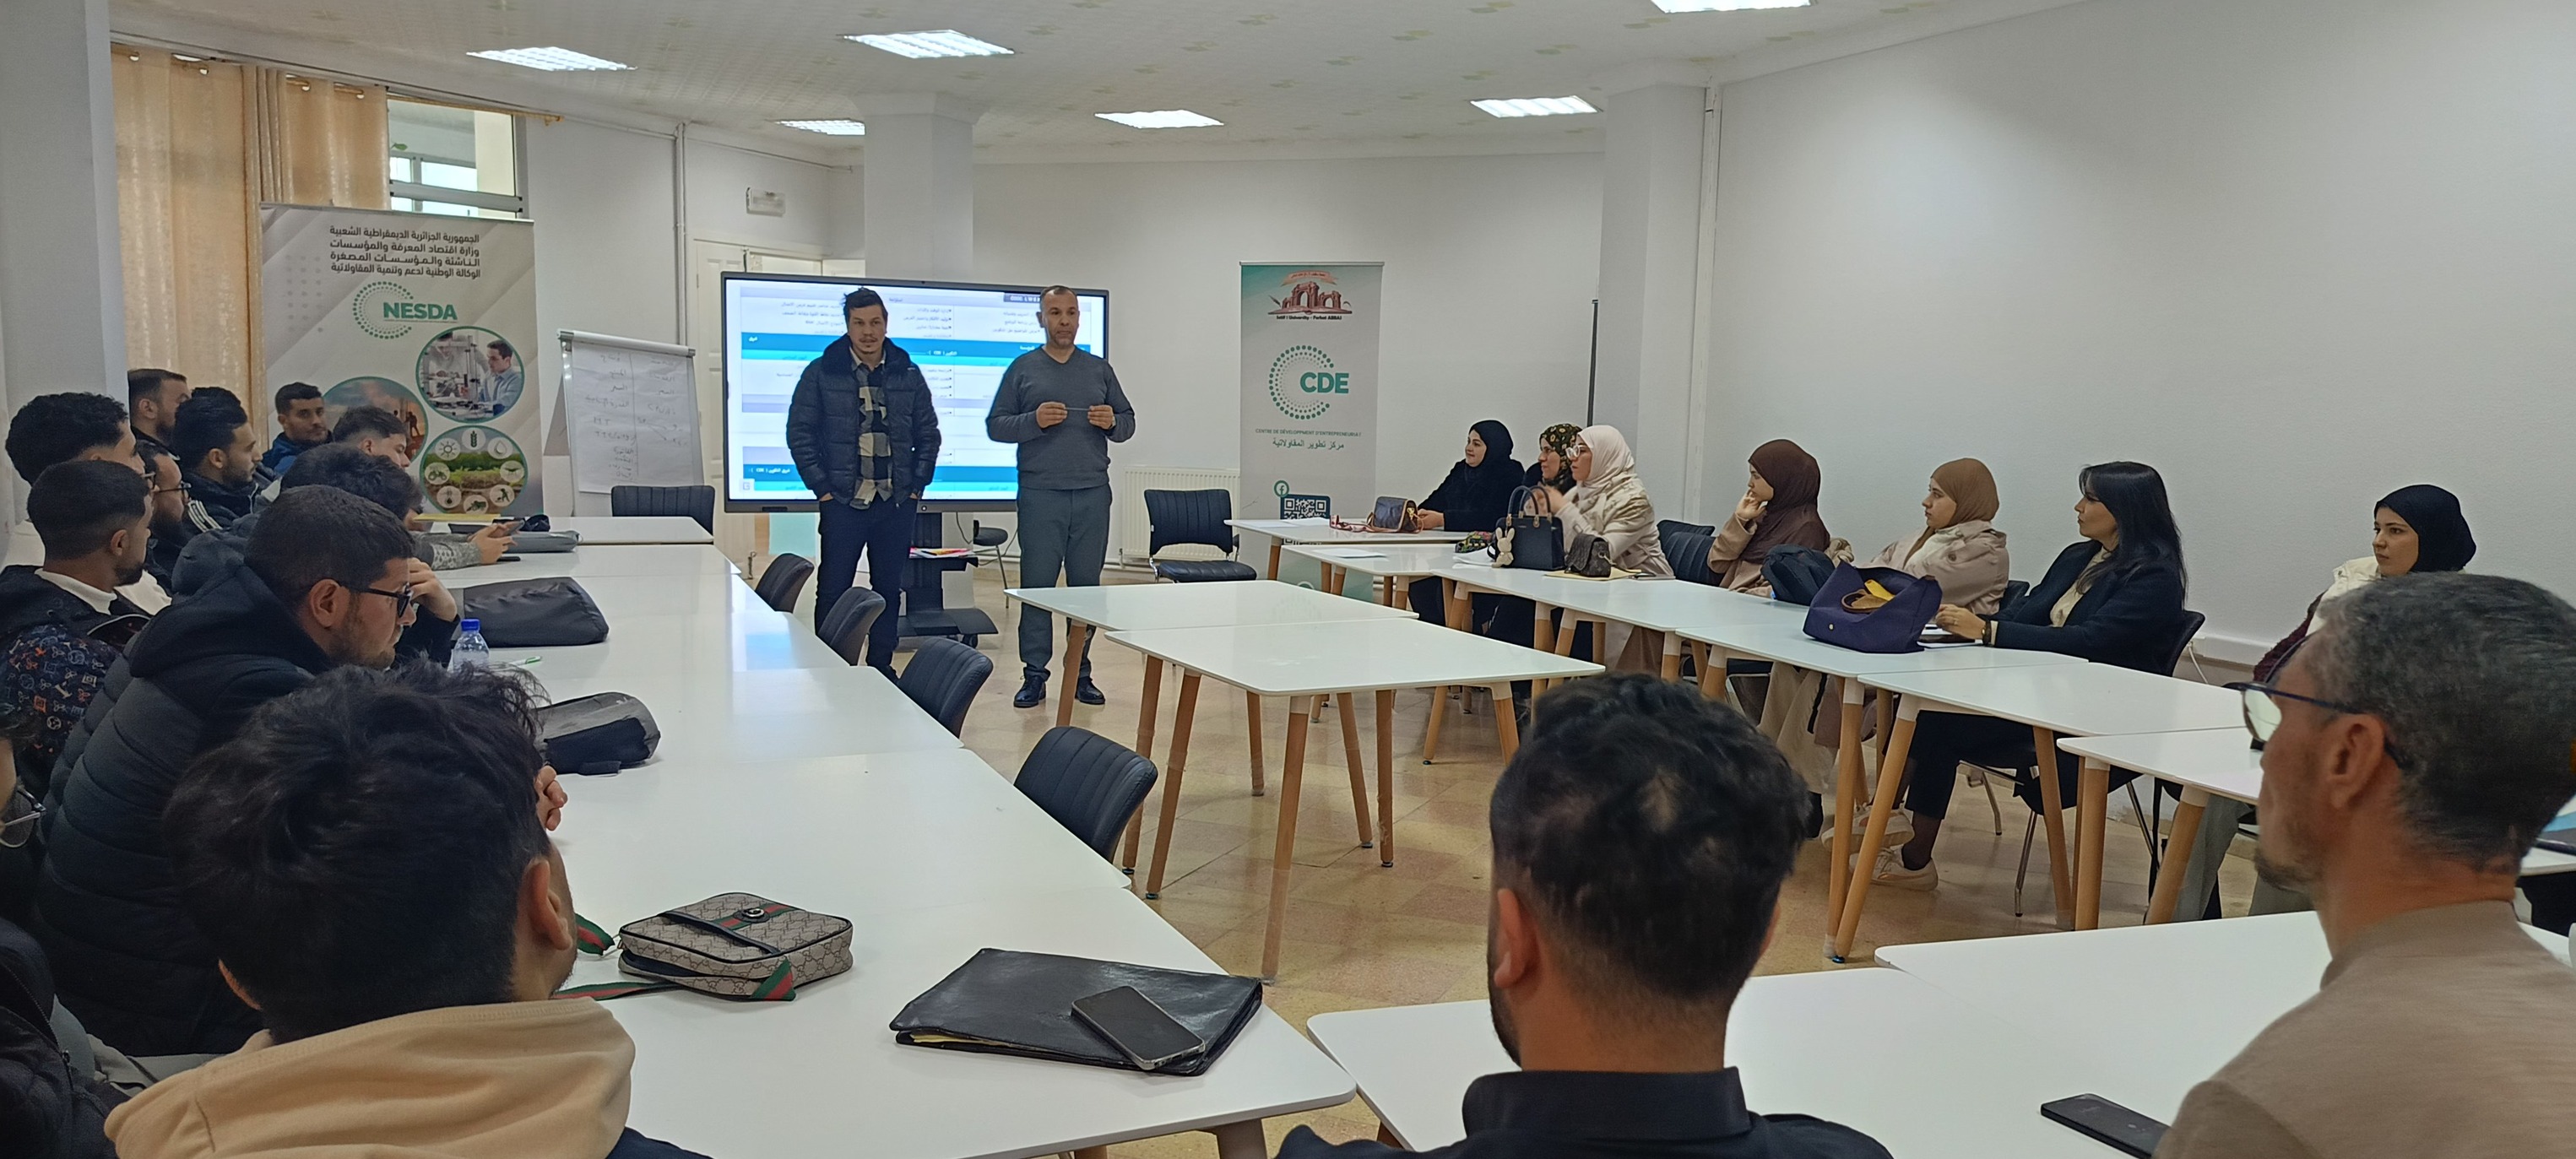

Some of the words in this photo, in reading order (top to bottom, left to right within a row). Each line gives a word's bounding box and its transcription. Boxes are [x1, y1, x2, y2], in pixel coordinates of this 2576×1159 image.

[329, 225, 361, 237] الشعبية
[363, 229, 409, 240] الديمقراطية
[410, 231, 442, 242] الجزائرية
[442, 234, 480, 245] الجمهورية
[329, 239, 388, 252] والمؤسسات
[391, 242, 426, 253] المعرفة
[428, 244, 458, 254] اقتصاد
[330, 251, 371, 262] المصغرة
[459, 246, 480, 257] وزارة
[374, 253, 442, 267] والمؤسسات
[445, 257, 480, 267] الناشئة
[331, 263, 375, 274] المقاولاتية
[377, 265, 403, 276] وتنمية
[404, 267, 424, 276] لدعم
[426, 267, 454, 279] الوطنية
[455, 268, 481, 279] الوكالة
[383, 302, 458, 320] NESDA
[1300, 371, 1349, 393] CDE
[1272, 437, 1304, 448] المقاولاتية
[1307, 440, 1326, 449] تطوير
[1328, 441, 1344, 450] مركز
